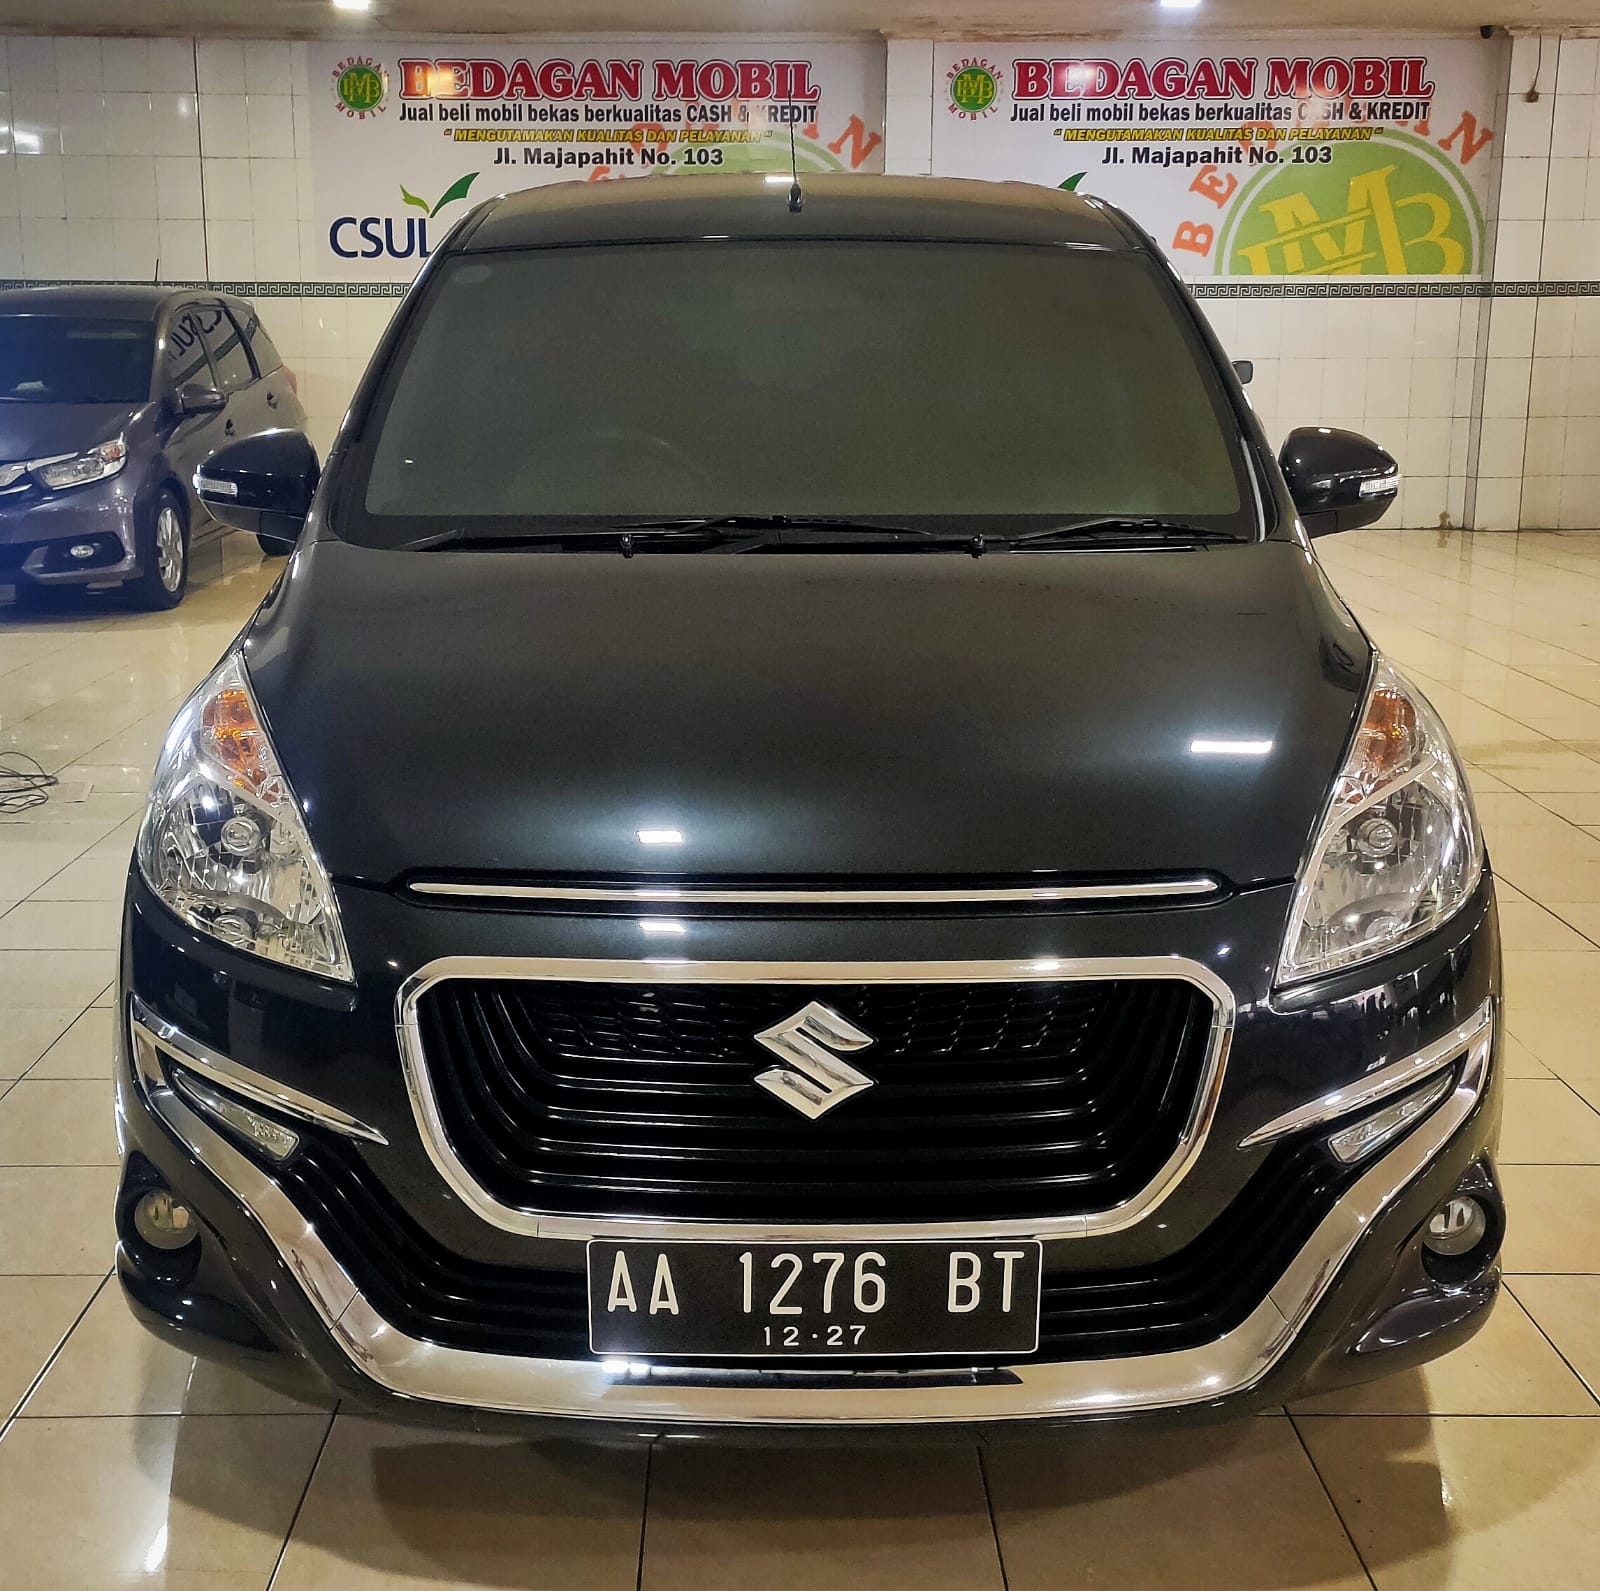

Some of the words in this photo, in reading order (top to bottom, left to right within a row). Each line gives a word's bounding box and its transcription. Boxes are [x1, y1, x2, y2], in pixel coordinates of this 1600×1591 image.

[332, 55, 390, 79] BEDAGA
[946, 57, 1004, 80] BEDAGAN
[398, 58, 643, 101] BEDAGAN
[652, 60, 821, 101] MOBIL
[1012, 57, 1257, 100] BEDAGAN
[1265, 57, 1435, 99] MOBIL
[336, 102, 386, 120] MOBIL
[400, 103, 433, 121] Jual
[439, 103, 470, 121] beli
[475, 103, 523, 121] mobil
[528, 103, 579, 122] bekas
[585, 103, 682, 122] berkualitas
[687, 104, 732, 122] CASH
[757, 105, 817, 123] REDIT
[948, 103, 998, 121] MOBIL
[1010, 103, 1045, 121] Jual
[1050, 103, 1082, 121] beli
[1086, 103, 1134, 121] mobil
[1139, 102, 1190, 121] bekas
[1195, 102, 1292, 121] berkualitas
[1349, 102, 1362, 120] &
[1367, 102, 1430, 120] KREDIT
[454, 129, 574, 142] MENGUTAMAKAN
[577, 129, 643, 142] KUALITAS
[646, 129, 676, 142] DAN
[680, 129, 761, 142] PELAYANAN
[1064, 128, 1183, 141] MENGUTAMAKAN
[1186, 127, 1253, 141] KUALITAS
[1255, 127, 1288, 140] DAN
[1288, 127, 1372, 140] PELAYANAN
[493, 147, 517, 164] Jl.
[524, 147, 634, 168] Majapahit
[641, 148, 676, 165] No.
[684, 148, 723, 165] 103
[1102, 147, 1124, 164] Jl.
[1132, 147, 1242, 168] Majapahit
[1249, 147, 1283, 164] No.
[1291, 146, 1332, 164] 103
[329, 216, 432, 259] CSUL
[606, 1249, 679, 1316] AA
[738, 1250, 887, 1315] 1276
[946, 1250, 1025, 1314] BT
